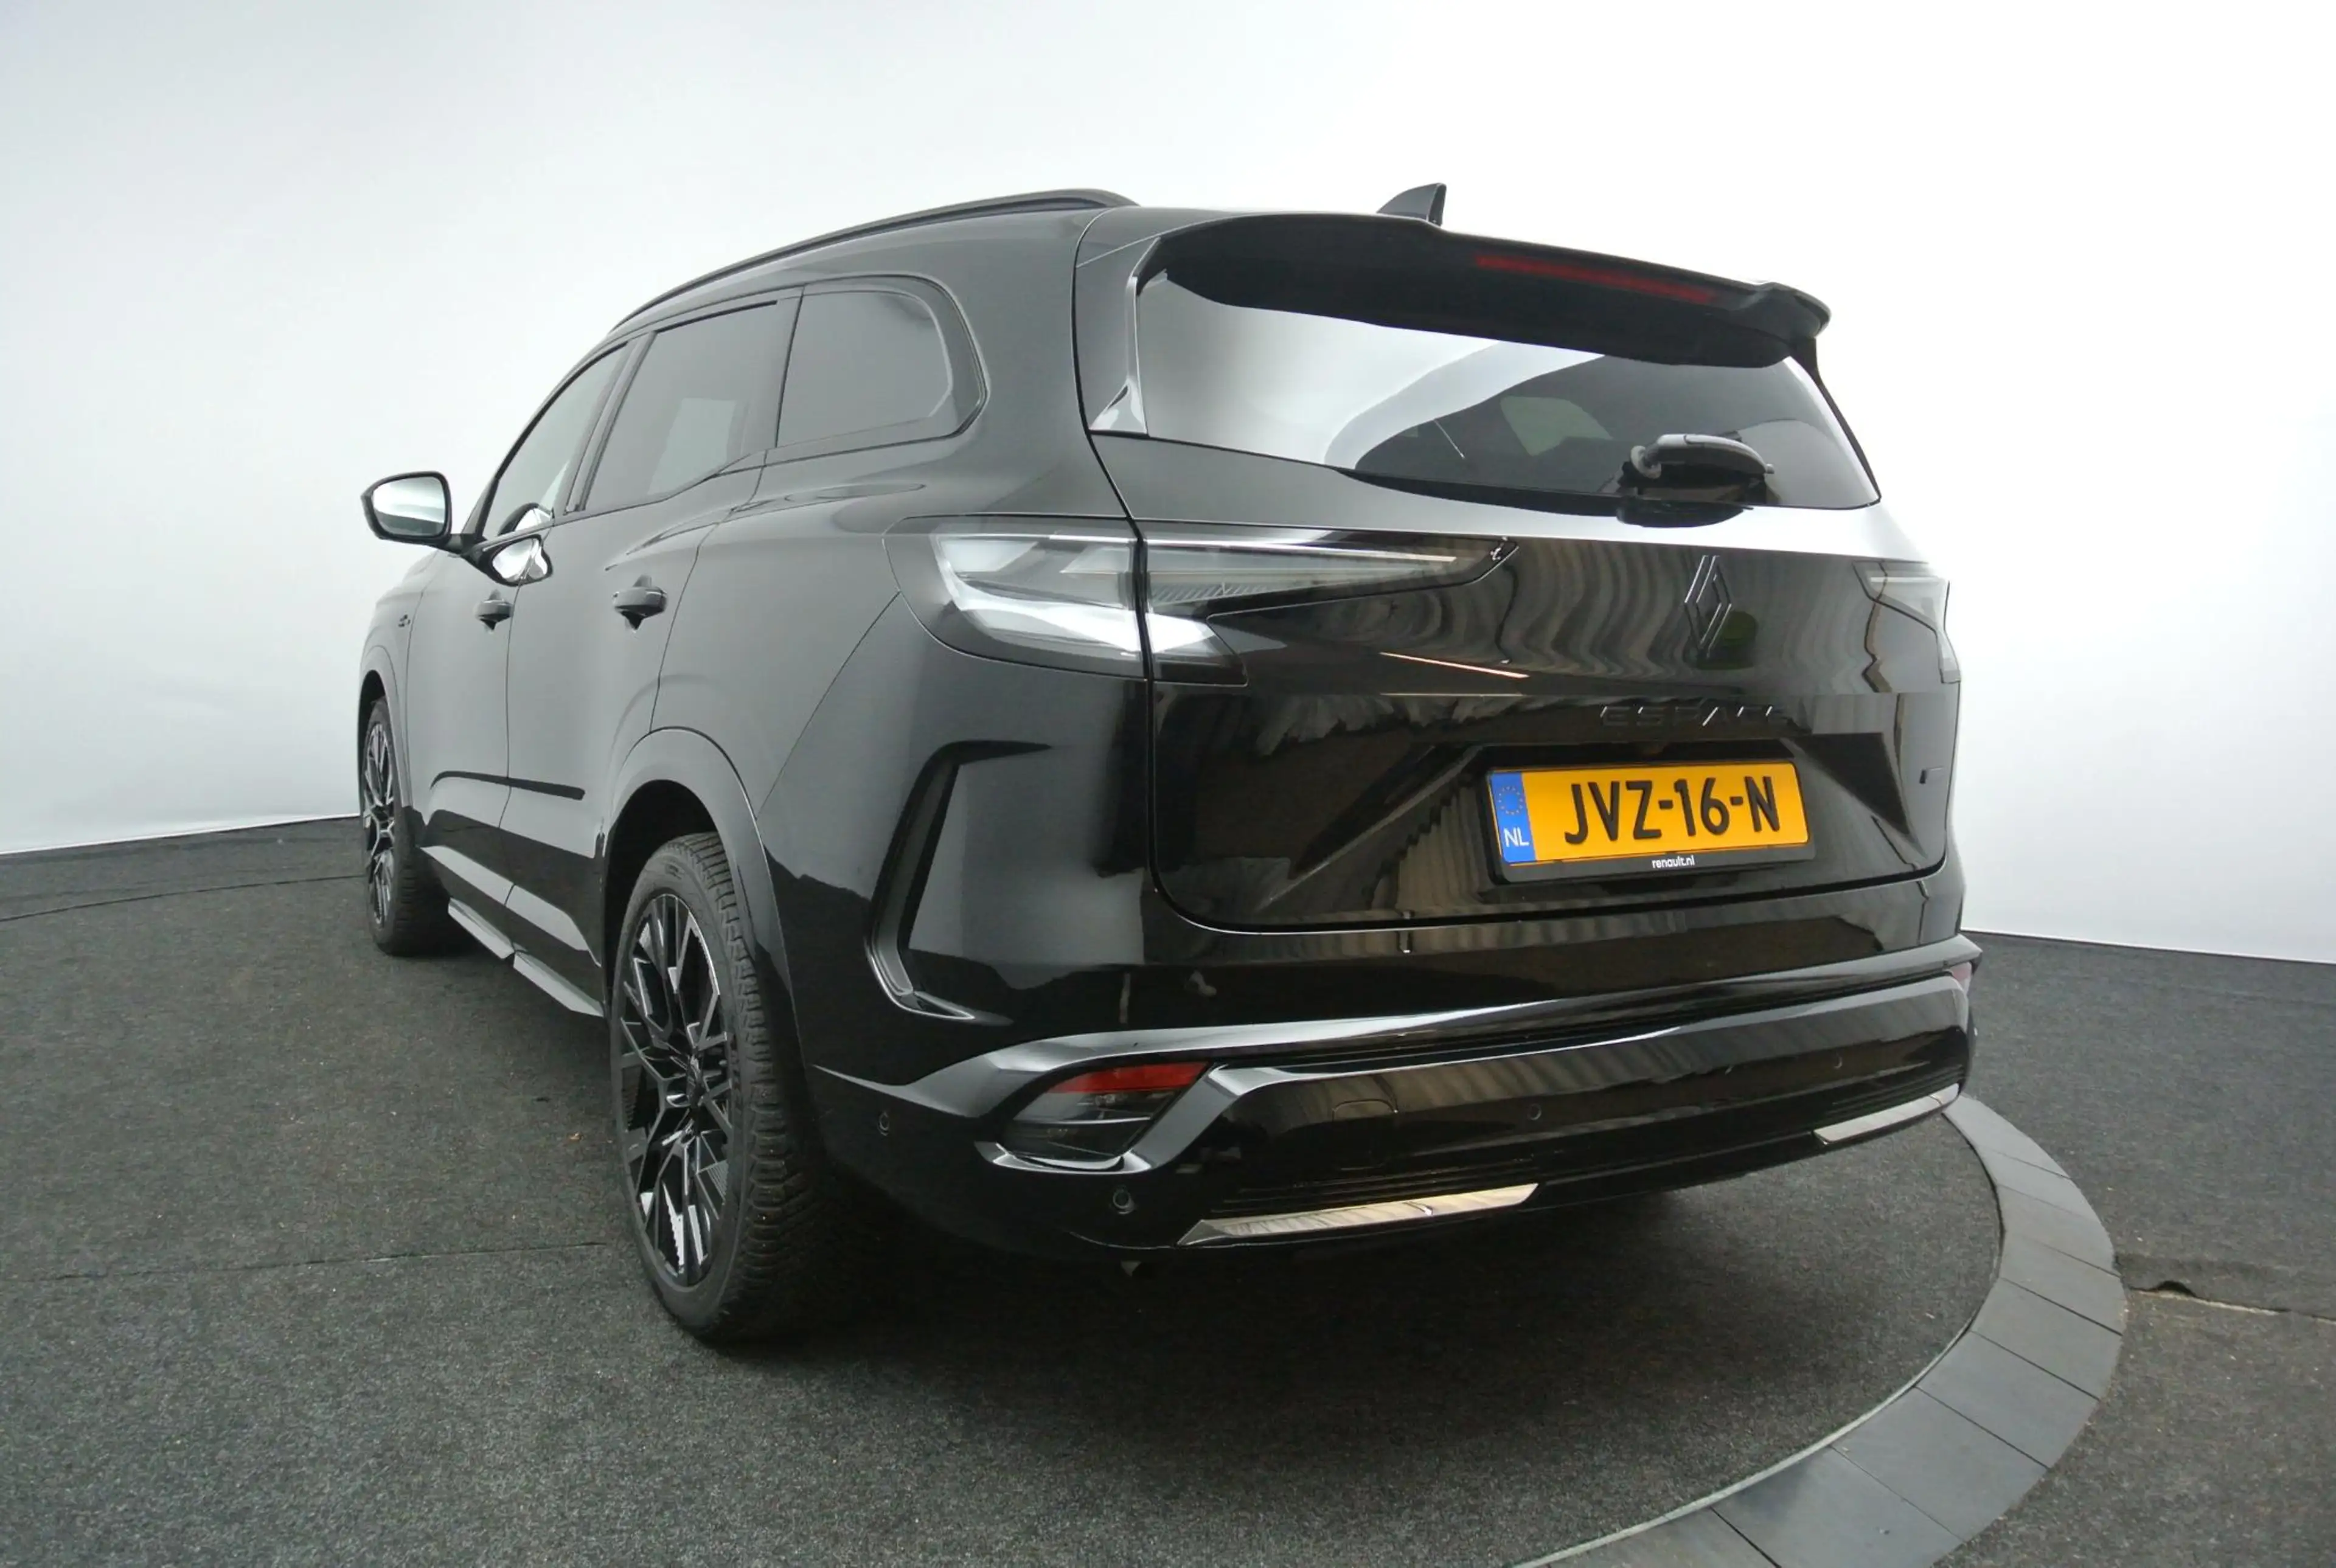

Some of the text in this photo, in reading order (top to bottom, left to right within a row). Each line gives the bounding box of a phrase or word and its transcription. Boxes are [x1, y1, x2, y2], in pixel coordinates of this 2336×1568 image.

[1564, 775, 1781, 845] JVZ-16-N
[1503, 827, 1529, 847] NL
[1652, 855, 1695, 869] renault.nl
